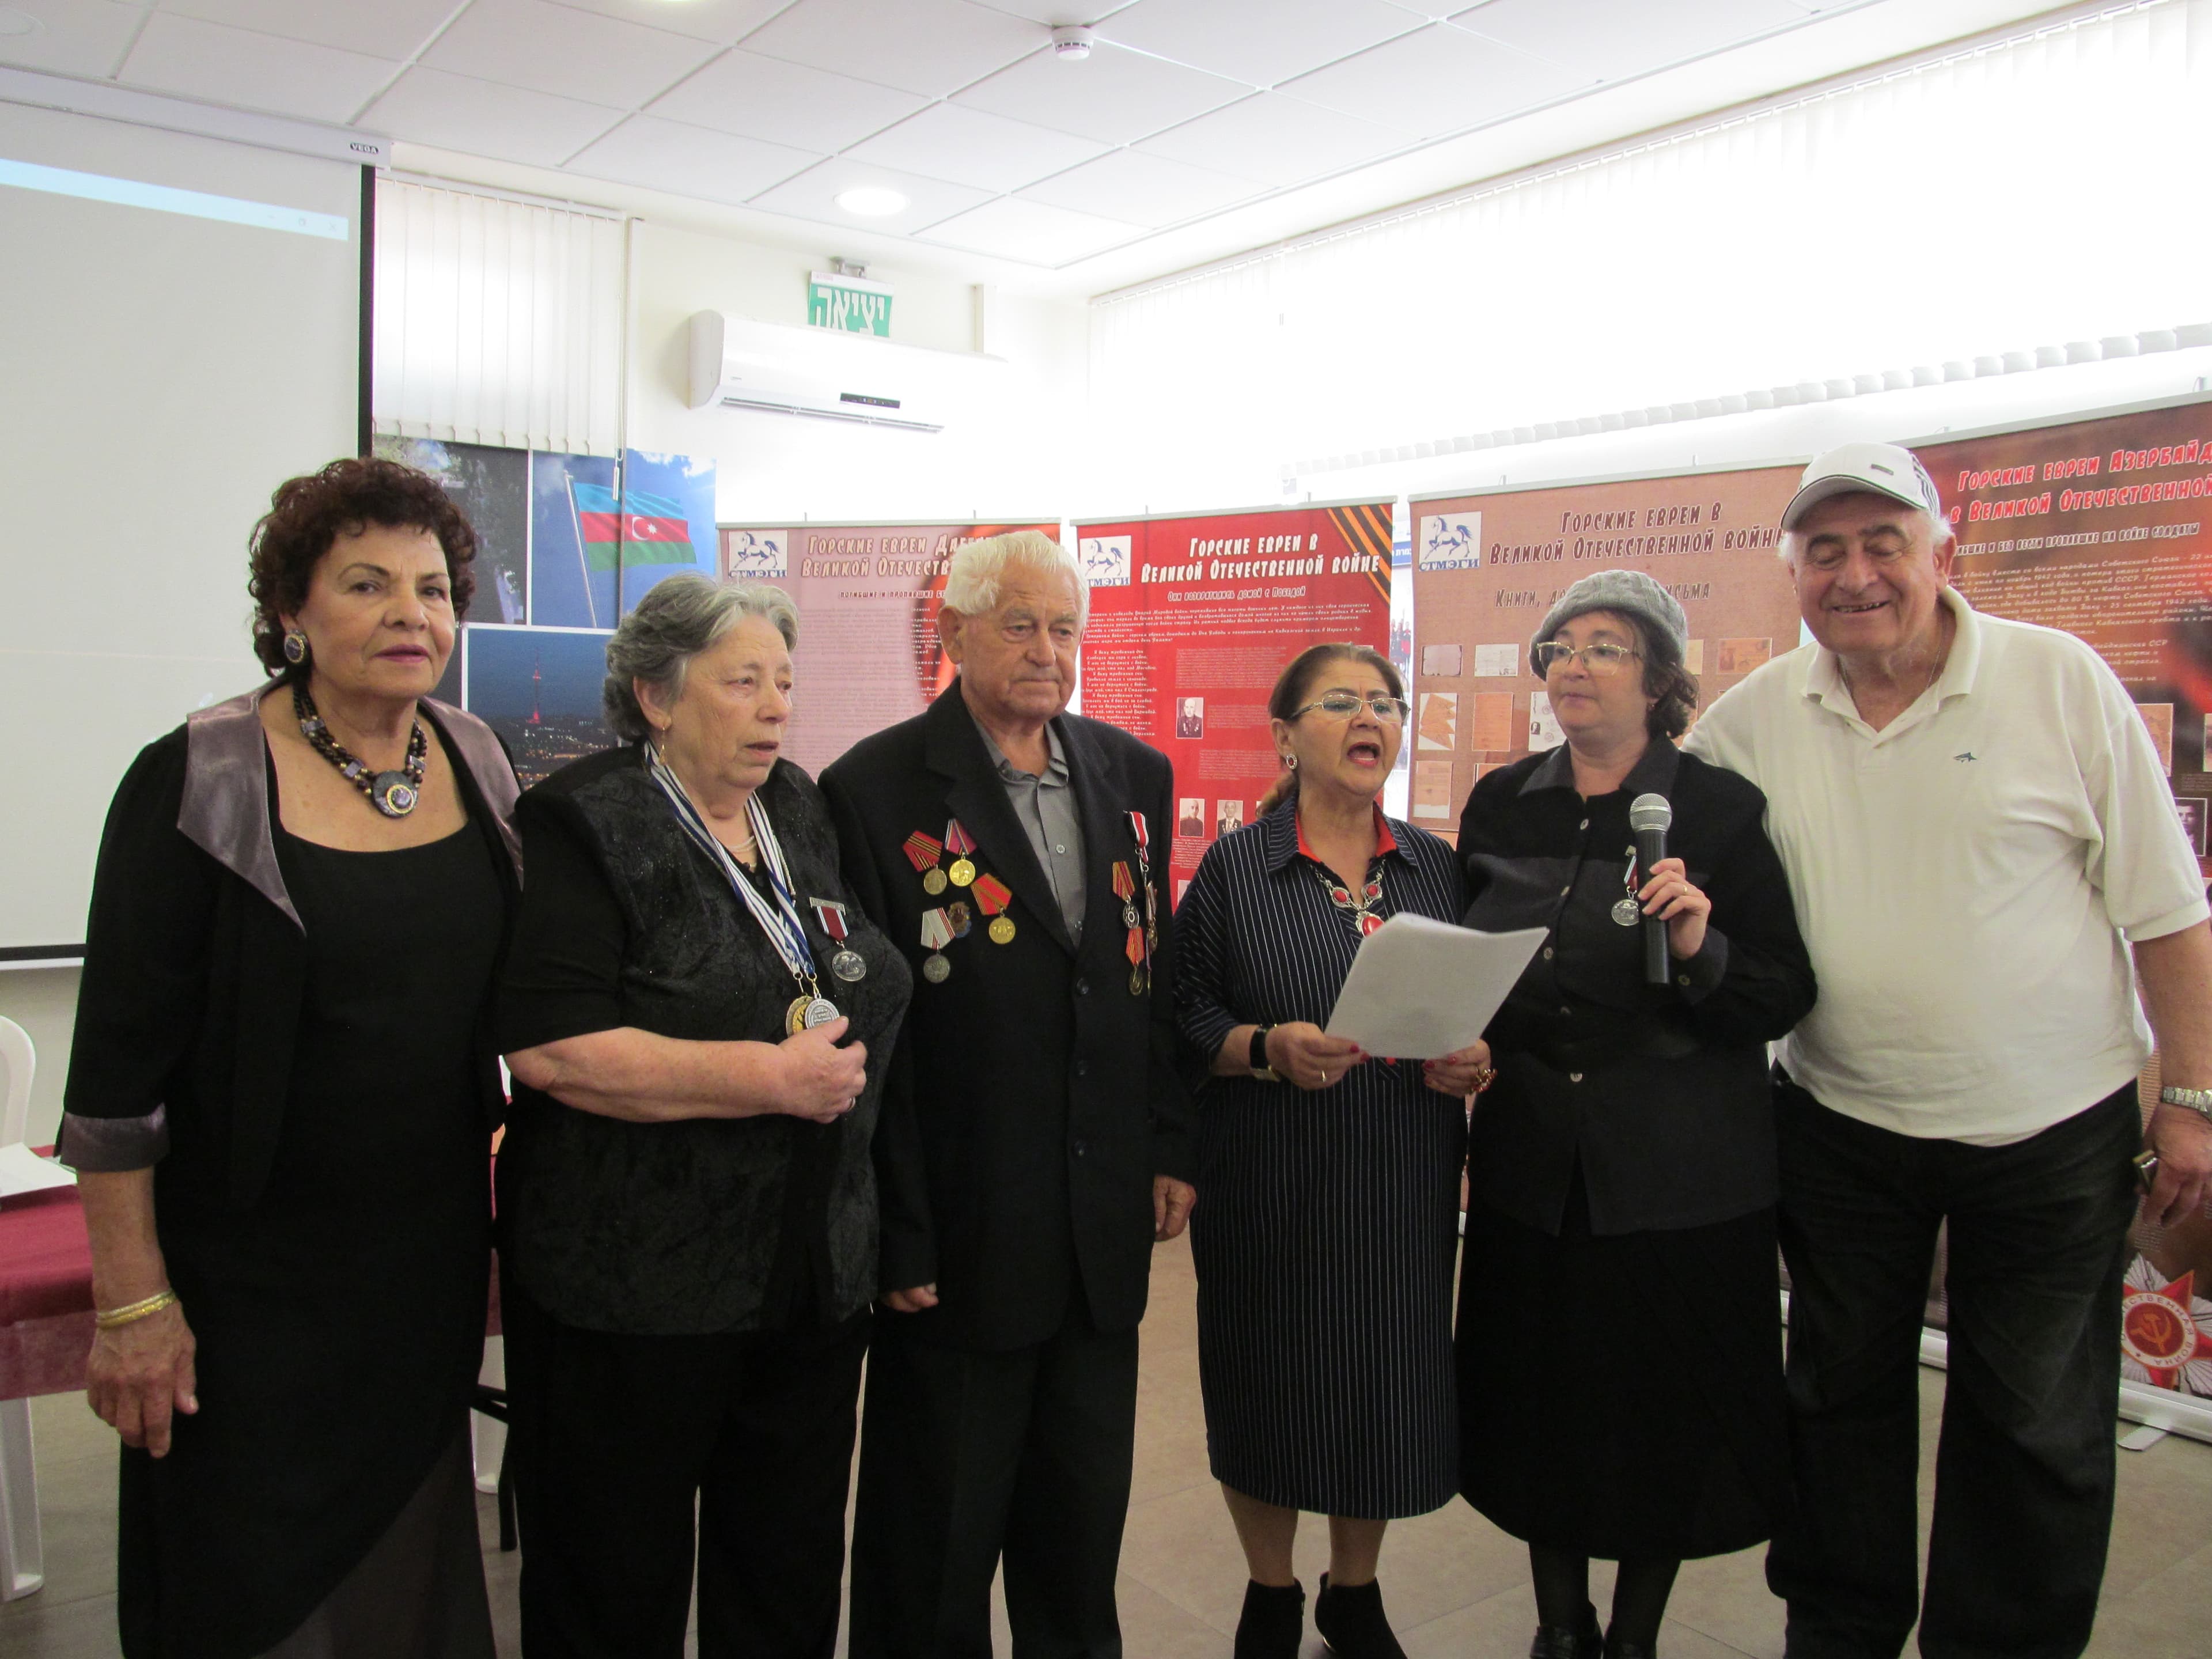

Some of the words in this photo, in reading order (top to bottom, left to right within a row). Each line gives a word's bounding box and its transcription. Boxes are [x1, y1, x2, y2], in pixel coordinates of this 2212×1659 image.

[816, 287, 885, 335] יציאה
[1958, 464, 2036, 491] ГОРСКИЕ
[2043, 457, 2101, 480] ЕВРЕИ
[2108, 439, 2212, 472] АЗЕРБАЙД
[1968, 492, 2051, 522] ВЕЛИКОЙ
[2059, 474, 2212, 512] ОТЕЧЕСТВЕННОЙ
[1560, 510, 1636, 533] ГОРСКИЕ
[1646, 505, 1700, 527] ЕВРЕИ
[1710, 502, 1722, 522] В
[2119, 525, 2149, 542] ВОЙНЕ
[2152, 522, 2200, 539] СОЛДАТЫ
[809, 535, 874, 555] ГОРСКИЕ
[881, 537, 927, 554] ЕВРЕИ
[1189, 536, 1250, 557] ГОРСКИЕ
[1257, 535, 1301, 554] ЕВРЕИ
[1309, 533, 1318, 551] В
[1489, 539, 1564, 566] ВЕЛИКОЙ
[1573, 528, 1715, 560] ОТЕЧЕСТВЕННОЙ
[802, 558, 870, 577] ВЕЛИКОЙ
[877, 558, 949, 576] ОТЕЧЕСТВ
[1141, 560, 1203, 584] ВЕЛИКОЙ
[1210, 554, 1324, 580] ОТЕЧЕСТВЕННОЙ
[1331, 551, 1381, 574] ВОЙНЕ
[1419, 558, 1480, 572] СТМЭГИ
[1087, 577, 1130, 587] ТМЭГИ
[840, 590, 877, 599] ПОГИБШИЕ
